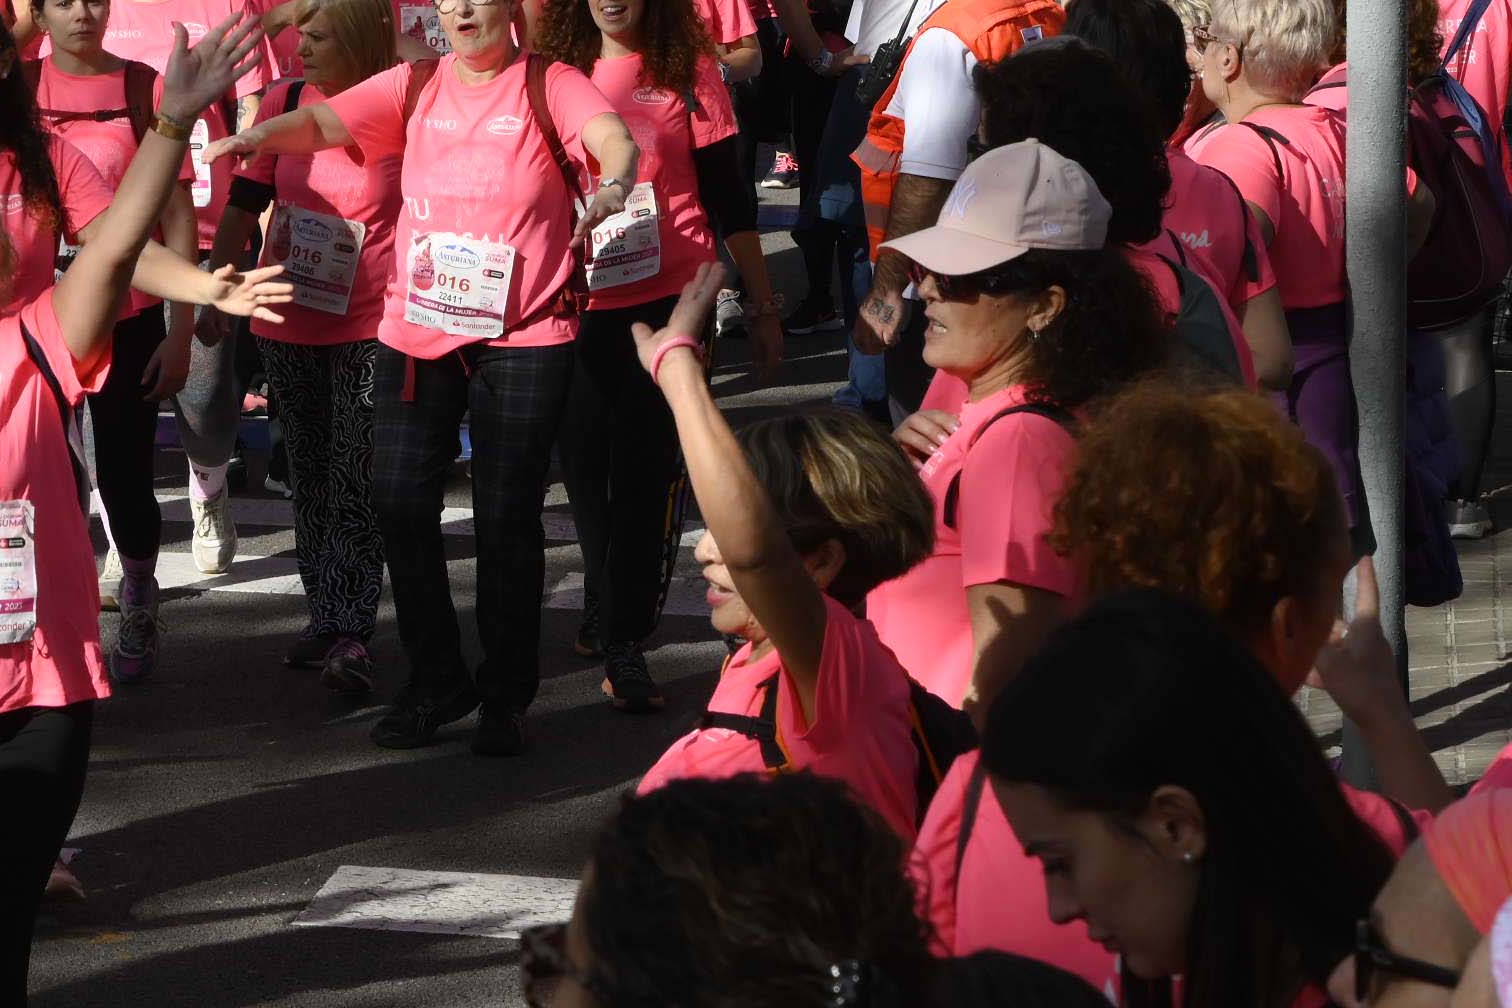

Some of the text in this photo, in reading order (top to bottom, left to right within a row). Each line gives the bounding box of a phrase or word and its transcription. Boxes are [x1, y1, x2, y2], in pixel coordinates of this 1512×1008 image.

[405, 197, 430, 221] TU
[593, 227, 626, 245] 016
[292, 245, 322, 264] 016
[440, 251, 476, 266] ASTURIANA
[437, 273, 471, 292] 016
[439, 291, 463, 305] 22411
[446, 306, 455, 314] LA
[456, 308, 477, 316] MUJER
[461, 321, 496, 330] Santander
[4, 601, 23, 611] 2023
